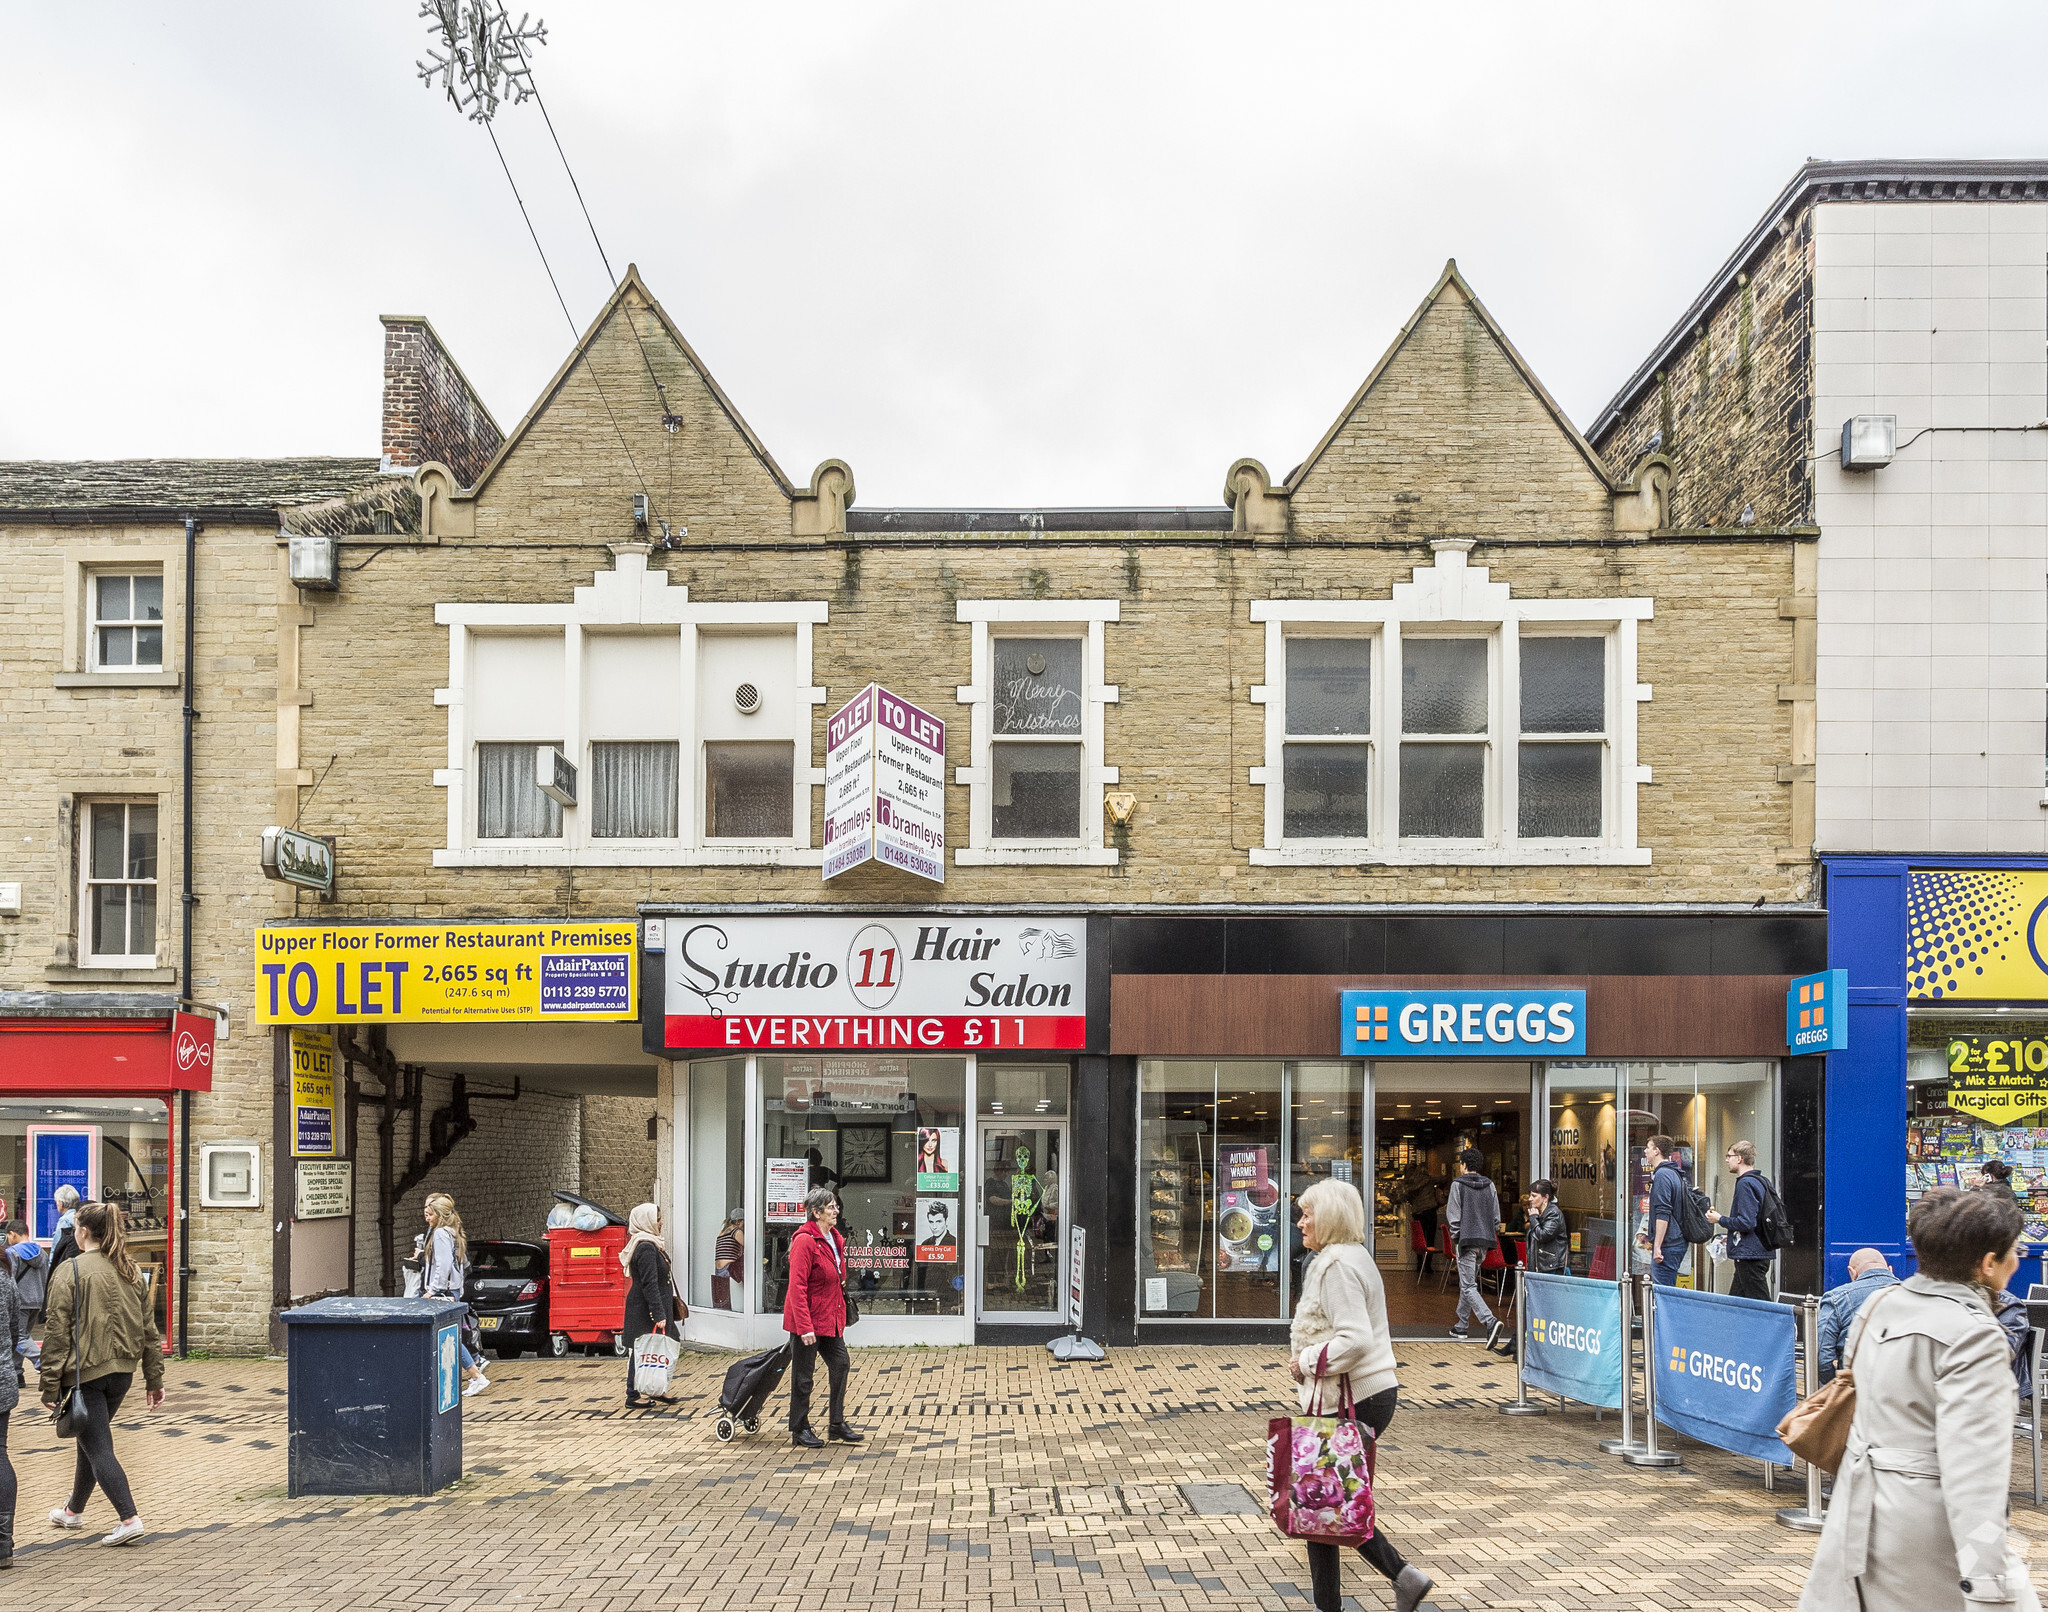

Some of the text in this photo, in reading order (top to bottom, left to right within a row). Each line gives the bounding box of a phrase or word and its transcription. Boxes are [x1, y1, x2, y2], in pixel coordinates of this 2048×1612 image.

[831, 696, 870, 746] TO LET
[882, 698, 940, 748] TO LET
[835, 735, 863, 763] Upper Floor
[891, 735, 932, 764] Upper Floor
[826, 750, 871, 788] Former Restaurant
[878, 750, 943, 790] Former Restaurant
[838, 781, 852, 799] 2,665
[878, 787, 895, 799] Suitable
[902, 796, 922, 811] alternative
[923, 806, 932, 816] uses
[898, 780, 917, 797] 2,665
[834, 807, 871, 841] bramleys
[892, 810, 943, 848] bramleys
[829, 831, 866, 856] www.bramleys.com
[884, 832, 937, 859] www.bramleys.com
[828, 845, 866, 874] 01484 530361
[884, 846, 937, 876] 01484 530361
[262, 928, 632, 954] Upper Floor Former Restaurant Premises
[910, 926, 1002, 963] Hair
[545, 958, 624, 972] AdairPaxton
[681, 924, 897, 993] Studio 11
[262, 961, 533, 1016] TO LET 2,665 sq ft
[444, 987, 510, 999] (247.6 sq m)
[543, 985, 626, 998] 0113 239 5770
[964, 972, 1072, 1009] Salon
[421, 1006, 533, 1015] Potential for Alternative Uses (STP)
[543, 1001, 626, 1011] www.adairpaxton.co.uk
[725, 1018, 1025, 1046] EVERYTHING £11
[1400, 1002, 1575, 1044] GREGGS
[1795, 1028, 1828, 1046] GREGGS
[294, 1050, 332, 1073] TO LET
[1950, 1040, 2048, 1073] 2 £10
[1968, 1055, 1983, 1064] only
[1970, 1047, 1981, 1056] for
[297, 1081, 331, 1097] 2,665 sq ft
[1966, 1074, 2034, 1086] Mix & Match
[1954, 1092, 2009, 1110] Magical
[2014, 1092, 2047, 1107] Gifts
[299, 1109, 330, 1120] AdairPaxton
[298, 1132, 310, 1140] 0113
[1230, 1152, 1256, 1164] AUTUMN
[1230, 1166, 1257, 1178] WARMER
[1561, 1158, 1597, 1185] baking
[848, 1258, 873, 1268] DAYS
[874, 1258, 882, 1268] A
[883, 1258, 909, 1268] WEEK
[850, 1246, 873, 1256] HAIR
[874, 1246, 906, 1256] SALON
[1549, 1321, 1601, 1355] GREGGS
[1689, 1350, 1762, 1393] GREGGS
